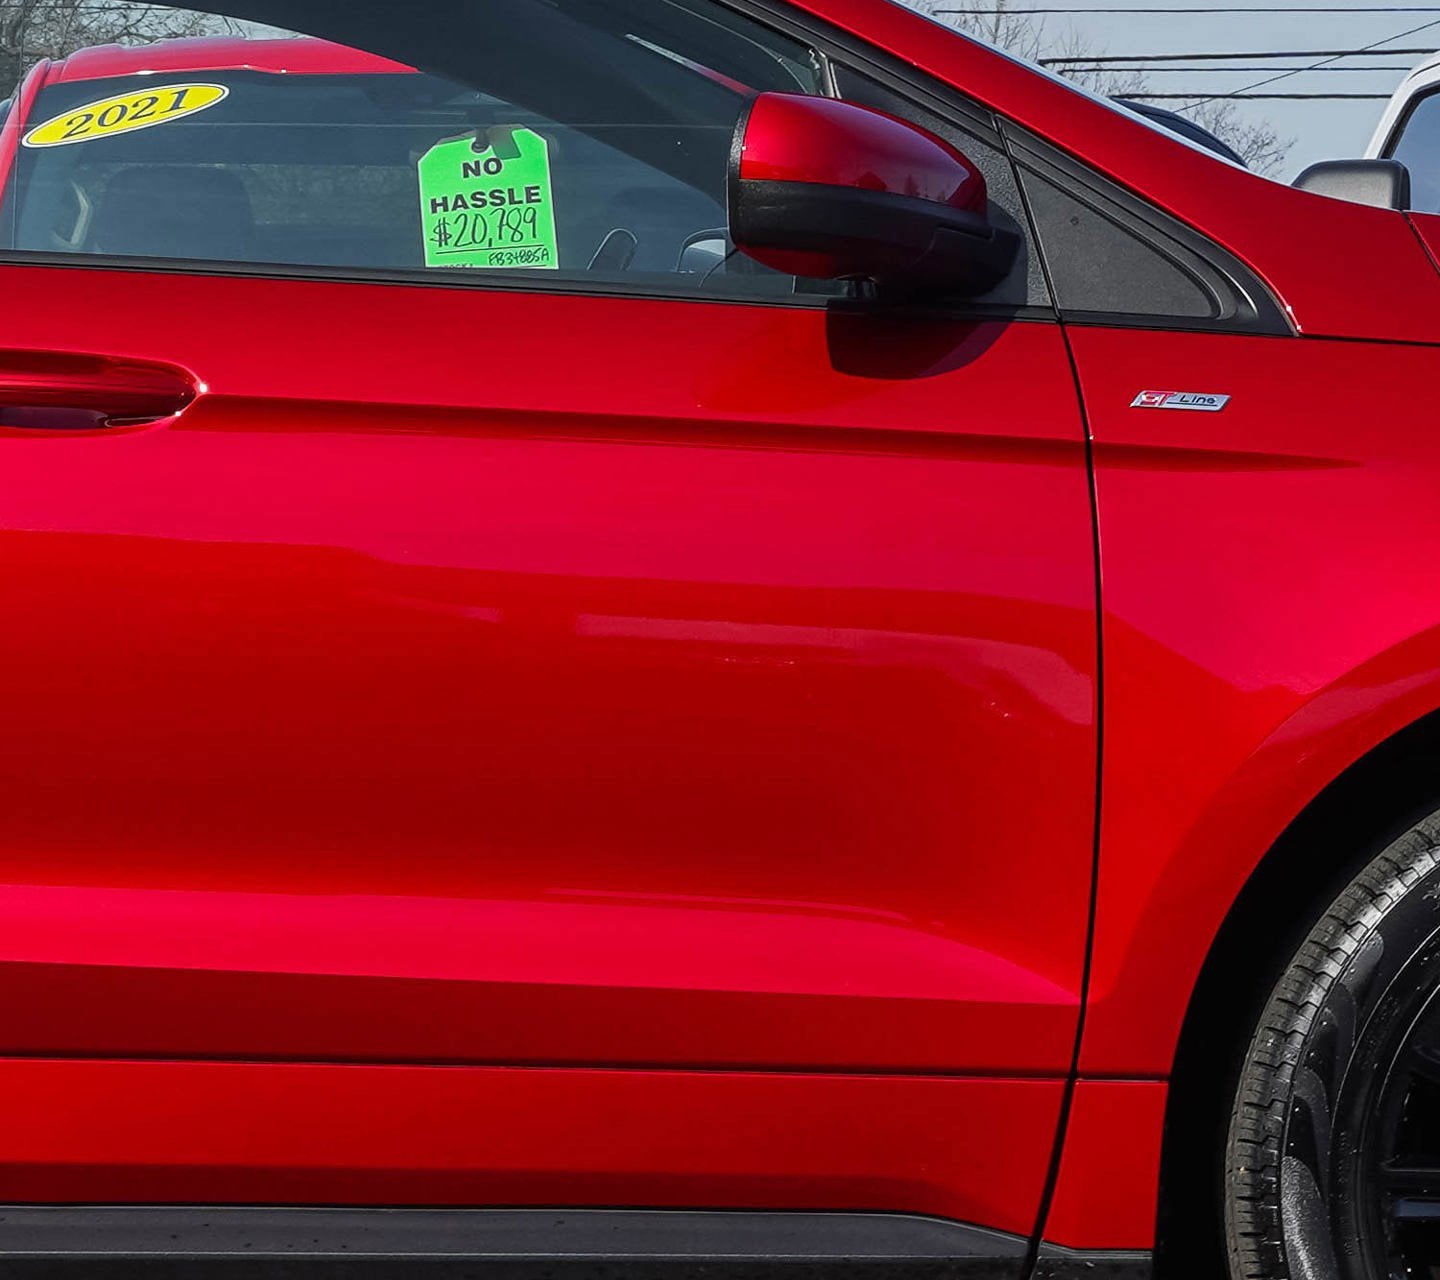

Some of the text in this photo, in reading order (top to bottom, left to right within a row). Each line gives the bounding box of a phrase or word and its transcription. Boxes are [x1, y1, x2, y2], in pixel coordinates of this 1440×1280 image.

[60, 87, 191, 140] 2021
[461, 157, 503, 179] NO
[429, 185, 542, 215] HASSLE
[429, 207, 538, 249] $20,789
